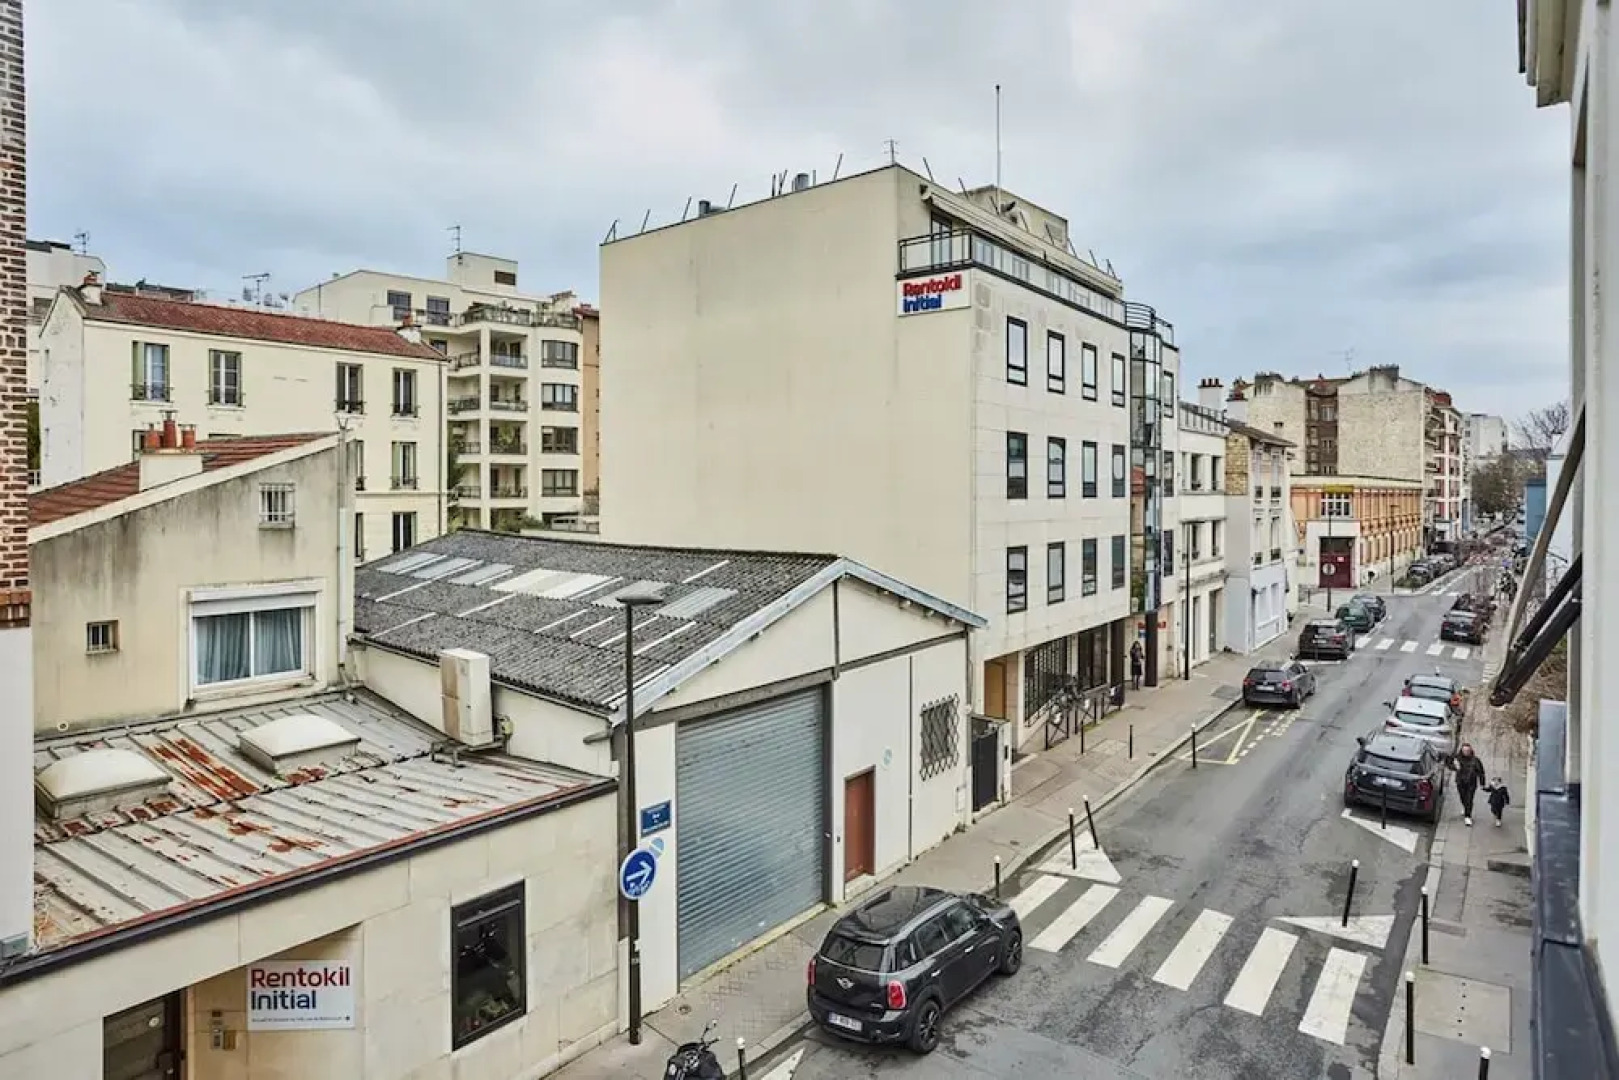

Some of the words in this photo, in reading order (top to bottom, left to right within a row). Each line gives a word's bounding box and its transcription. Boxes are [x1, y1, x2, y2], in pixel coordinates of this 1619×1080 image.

[903, 274, 962, 296] Rentokil
[903, 294, 942, 312] Initial
[251, 966, 350, 988] Rentokil
[251, 989, 317, 1010] Initial
